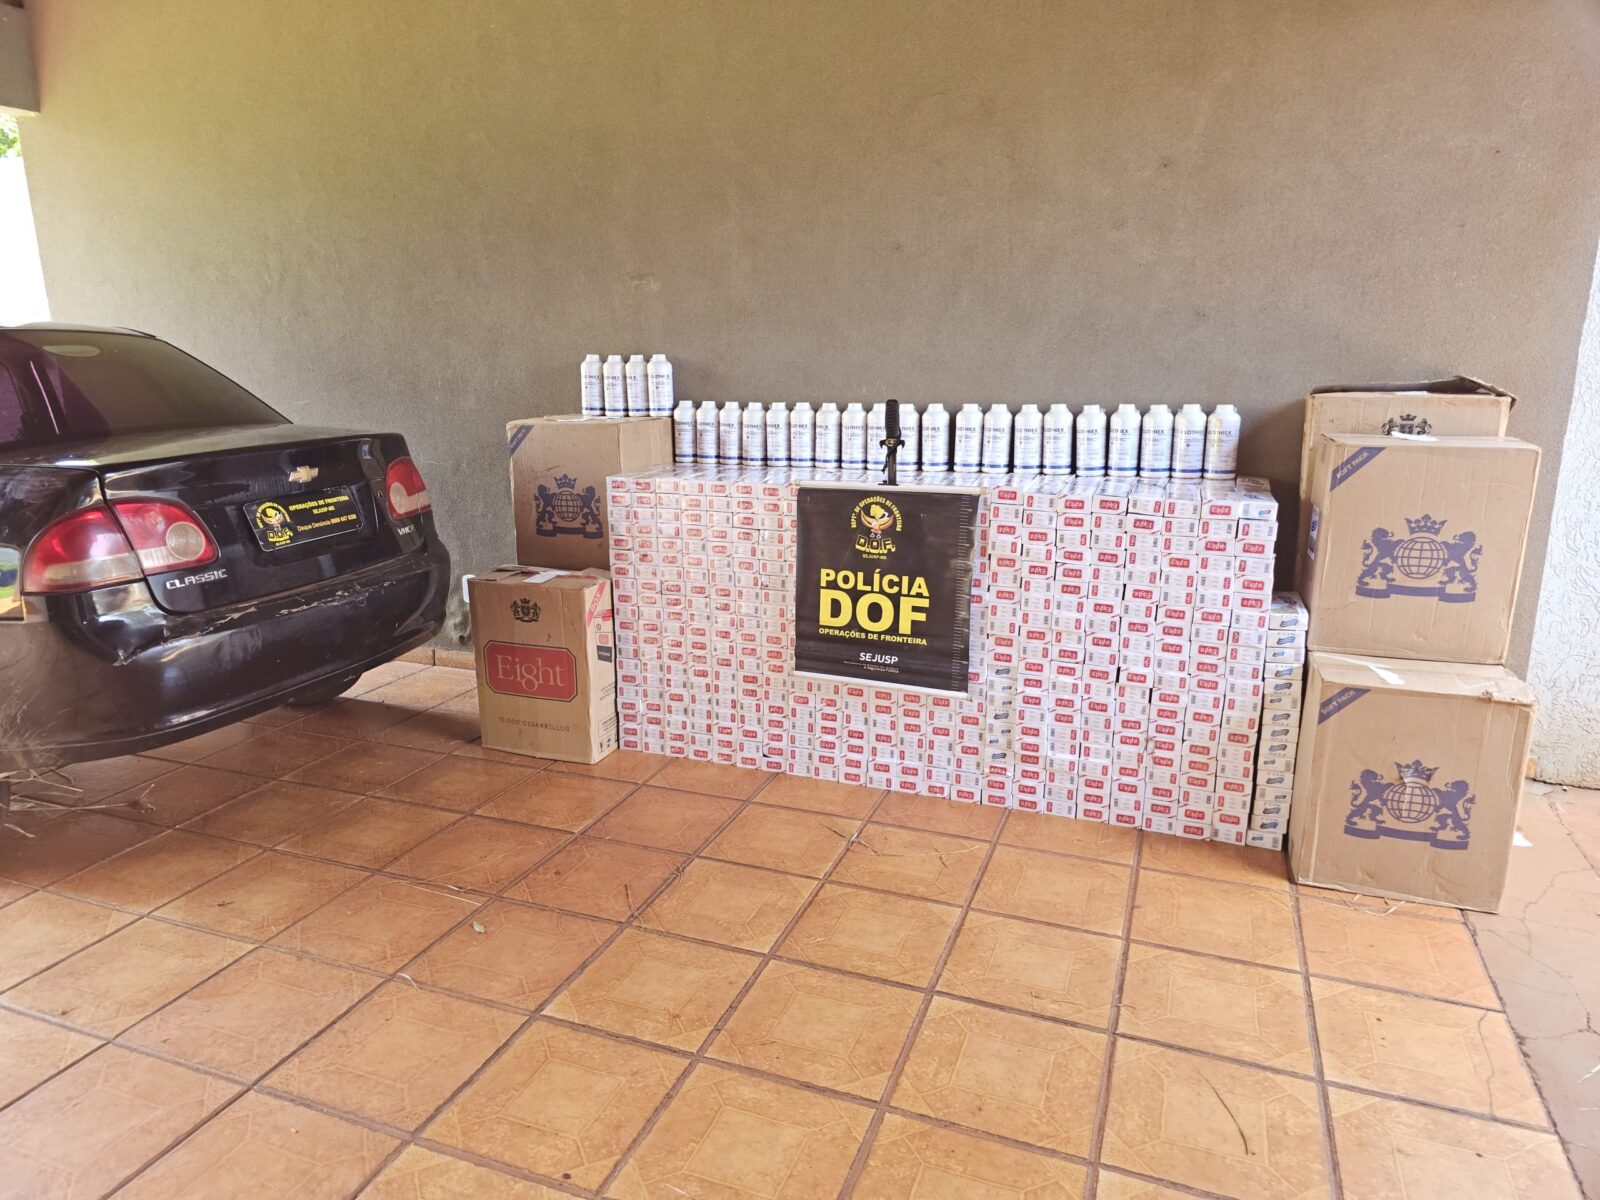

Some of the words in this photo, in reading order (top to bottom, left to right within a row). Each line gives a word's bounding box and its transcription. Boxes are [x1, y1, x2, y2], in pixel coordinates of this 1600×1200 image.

[1353, 451, 1370, 466] PACK
[166, 568, 228, 589] CLASSIC
[820, 568, 930, 597] POLÍCIA
[591, 593, 601, 612] BOX
[819, 588, 930, 635] DOF
[819, 628, 865, 639] OPERAÇÕES
[881, 635, 927, 646] FRONTEIRA
[859, 652, 898, 664] SEJUSP
[495, 655, 568, 692] Eight
[1321, 701, 1338, 714] SOFT
[1338, 690, 1356, 704] PACK
